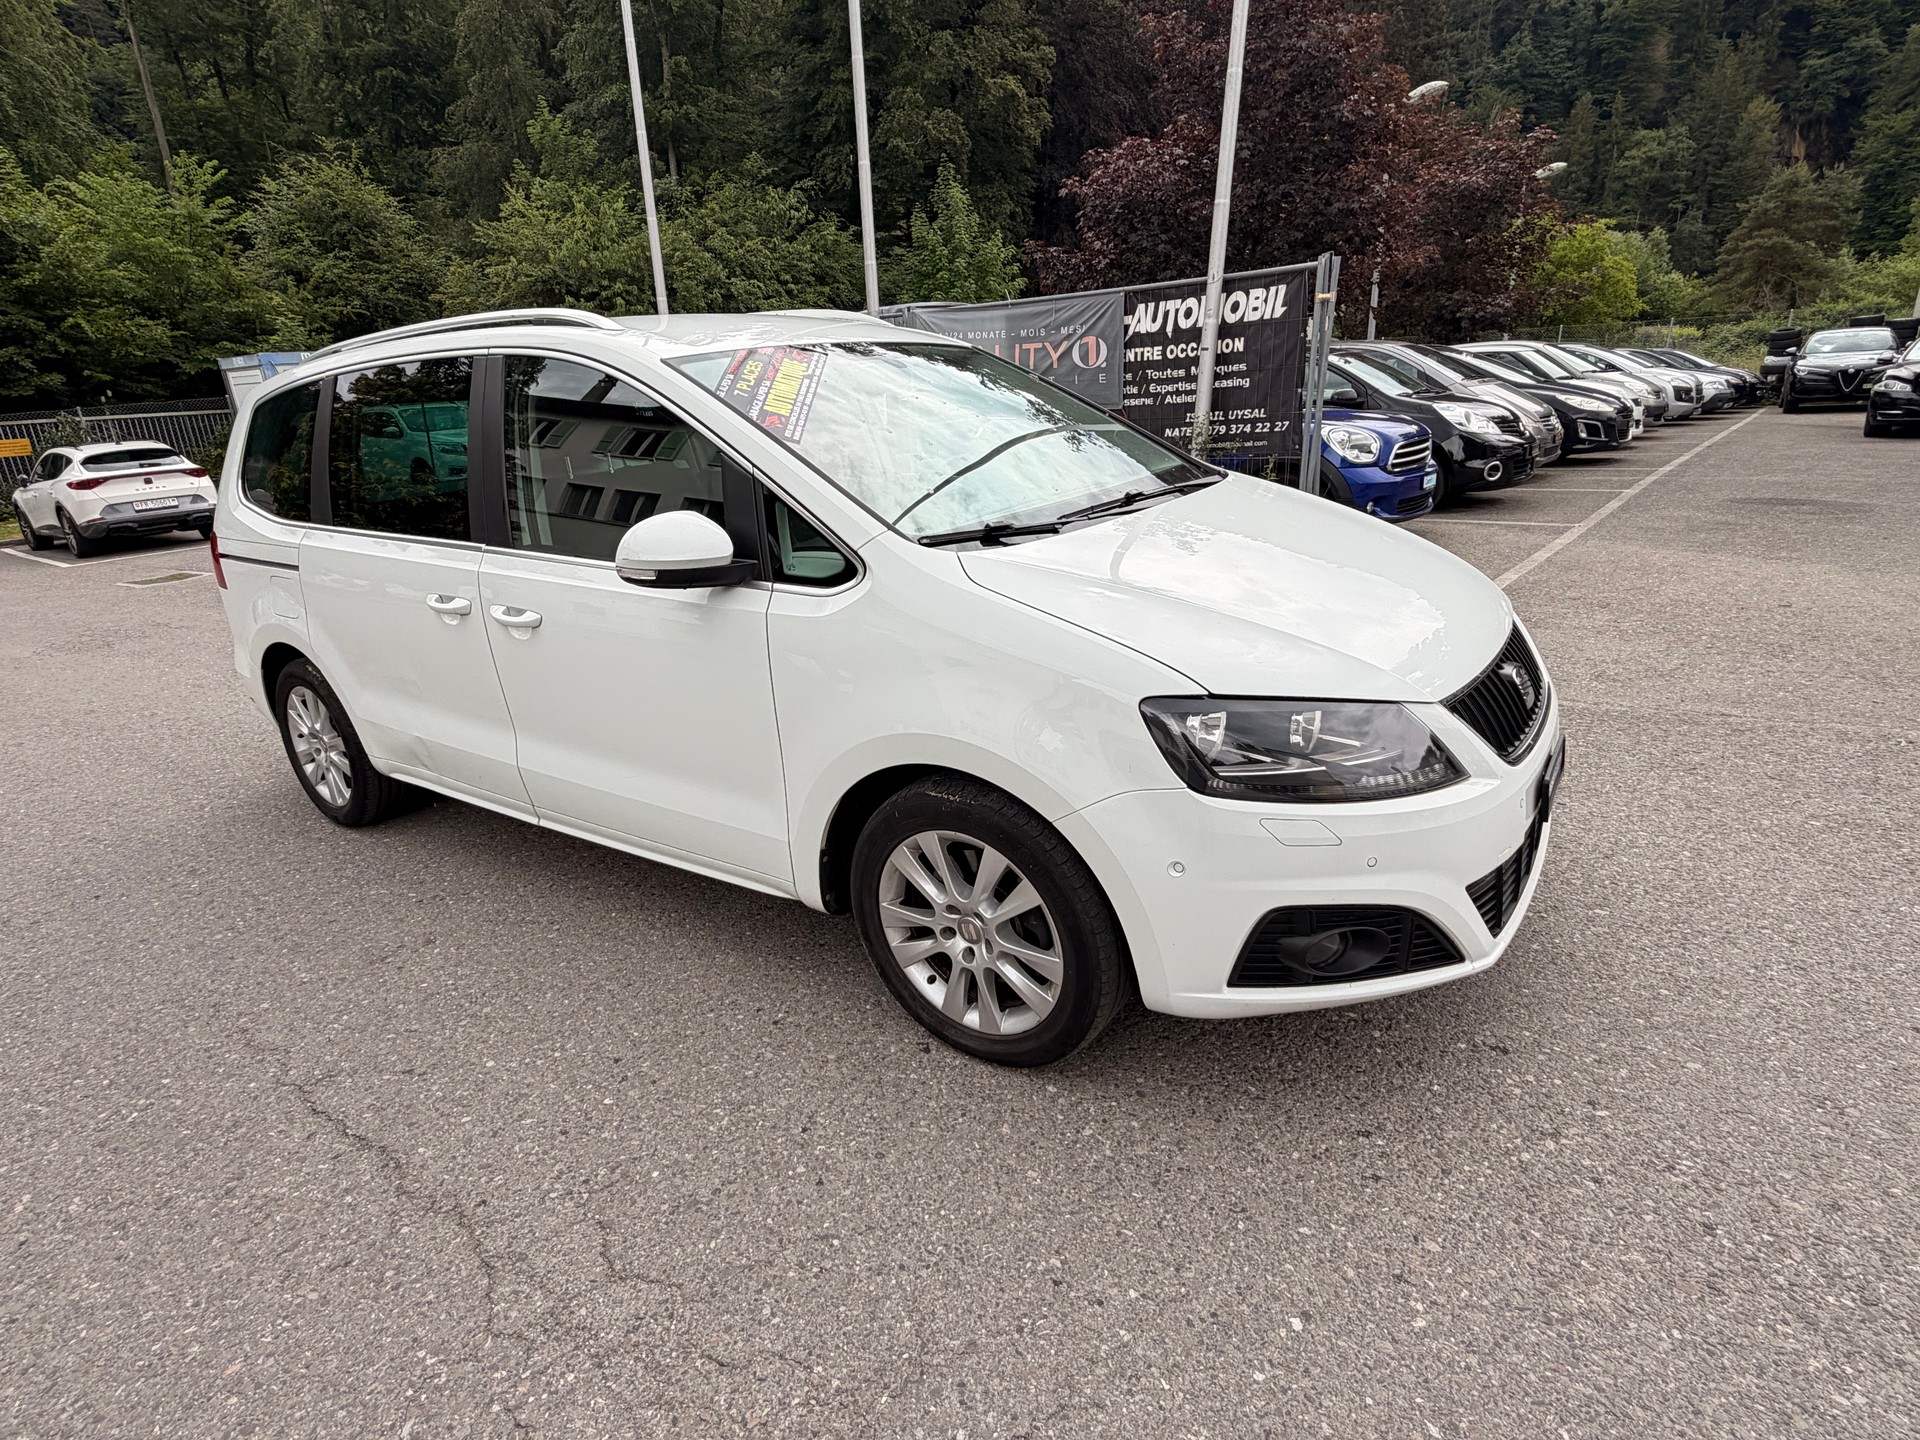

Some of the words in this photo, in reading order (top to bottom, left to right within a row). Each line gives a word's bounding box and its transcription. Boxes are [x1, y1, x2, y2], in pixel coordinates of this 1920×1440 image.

[967, 330, 1007, 340] MONATE
[1020, 328, 1046, 338] MOIS
[1124, 346, 1163, 363] NTRE
[1166, 337, 1245, 359] OCCION
[736, 360, 763, 391] PLACES
[1145, 368, 1186, 380] Toutes
[1190, 363, 1247, 376] Mques
[733, 389, 748, 397] 7
[763, 357, 808, 416] AUTOMATIQUE
[1149, 381, 1197, 395] Expertise
[1213, 377, 1250, 389] easing
[1164, 393, 1197, 404] Atelier
[1185, 411, 1226, 422] ISIL
[1228, 408, 1267, 420] UYSAL
[1164, 427, 1193, 437] NATE
[1228, 423, 1251, 434] 374
[1254, 422, 1271, 433] 22
[1273, 421, 1290, 432] 27
